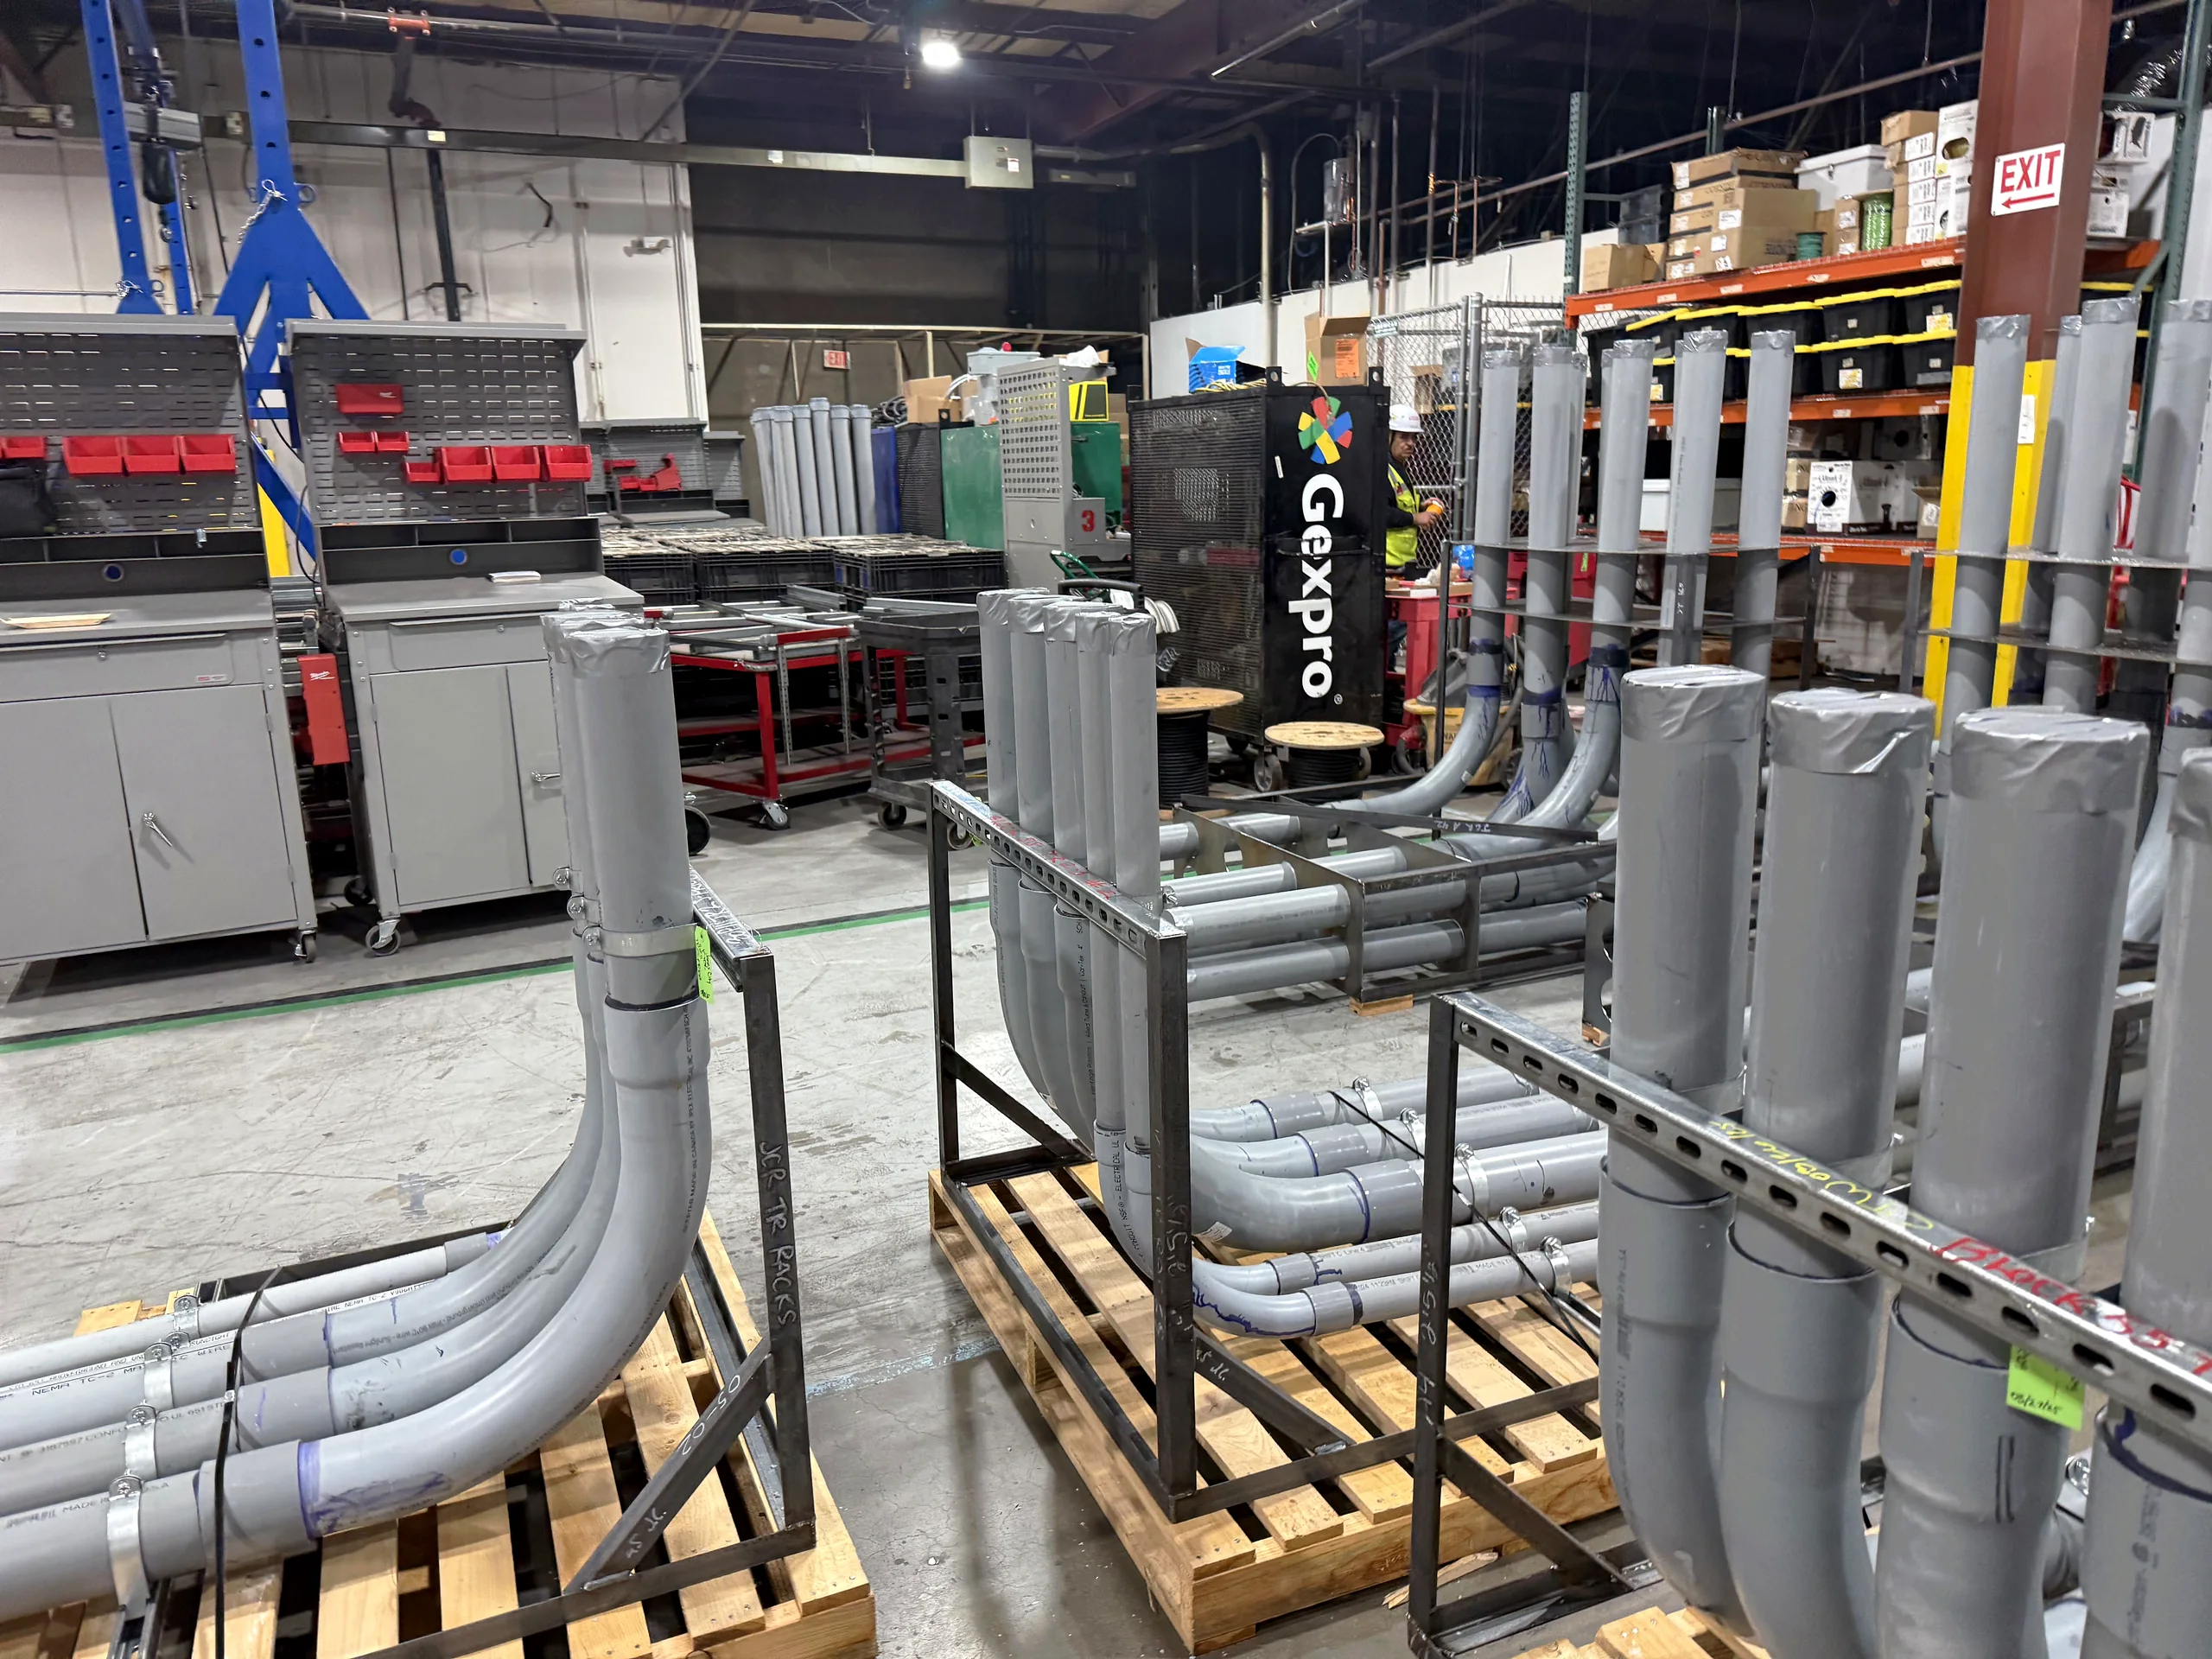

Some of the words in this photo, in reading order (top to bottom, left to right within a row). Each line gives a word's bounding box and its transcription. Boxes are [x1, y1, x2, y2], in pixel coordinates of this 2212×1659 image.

[2000, 149, 2061, 194] EXIT
[1081, 510, 1095, 532] 3
[1288, 474, 1344, 699] Gexpro
[1113, 1140, 1120, 1148] UL
[759, 1141, 787, 1191] JCR
[1113, 1151, 1122, 1192] ELECTRICAL
[766, 1196, 788, 1236] TR
[345, 1298, 365, 1307] NEMA
[770, 1244, 797, 1325] RACKS
[32, 1382, 71, 1396] NEMA
[80, 1372, 115, 1384] TC-2
[677, 1375, 741, 1456] 05-02
[62, 1500, 96, 1513] MADE
